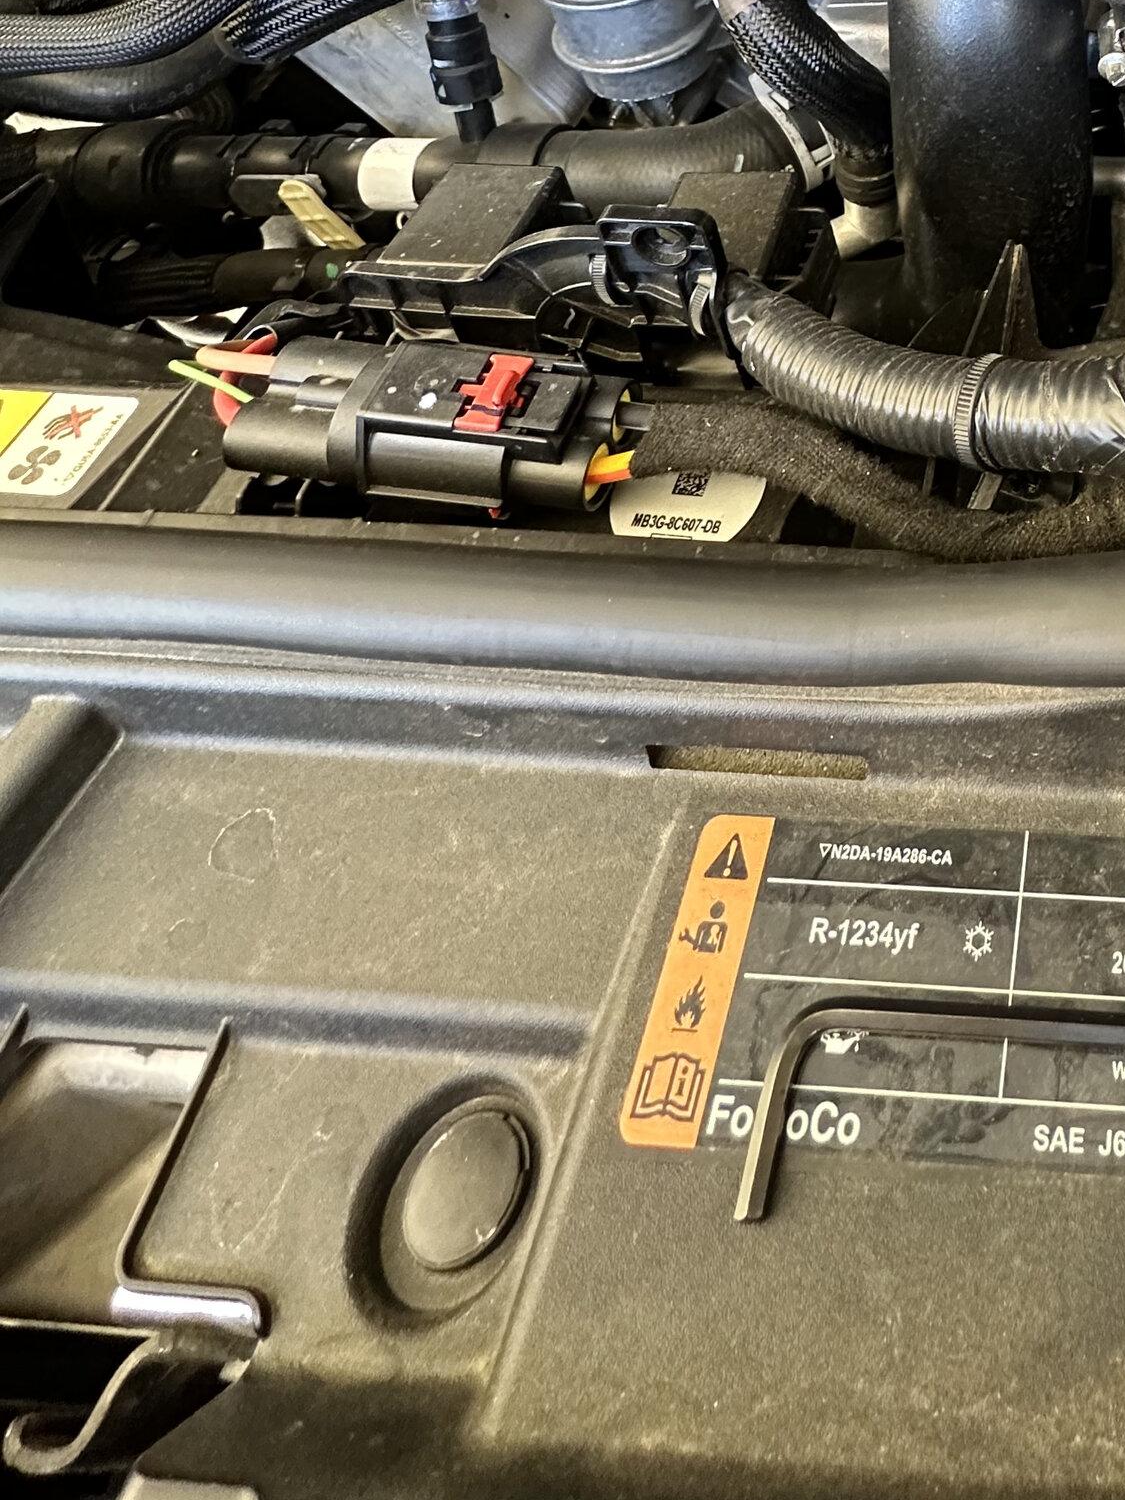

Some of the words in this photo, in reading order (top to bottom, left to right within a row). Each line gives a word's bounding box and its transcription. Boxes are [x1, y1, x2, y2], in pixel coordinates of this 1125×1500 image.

[631, 512, 722, 534] MB3G-8C607-DB
[831, 844, 953, 866] N2DA-19A286-CA
[808, 916, 921, 956] R-1234yf
[706, 1094, 861, 1146] FooCo
[1032, 1123, 1086, 1155] SAE
